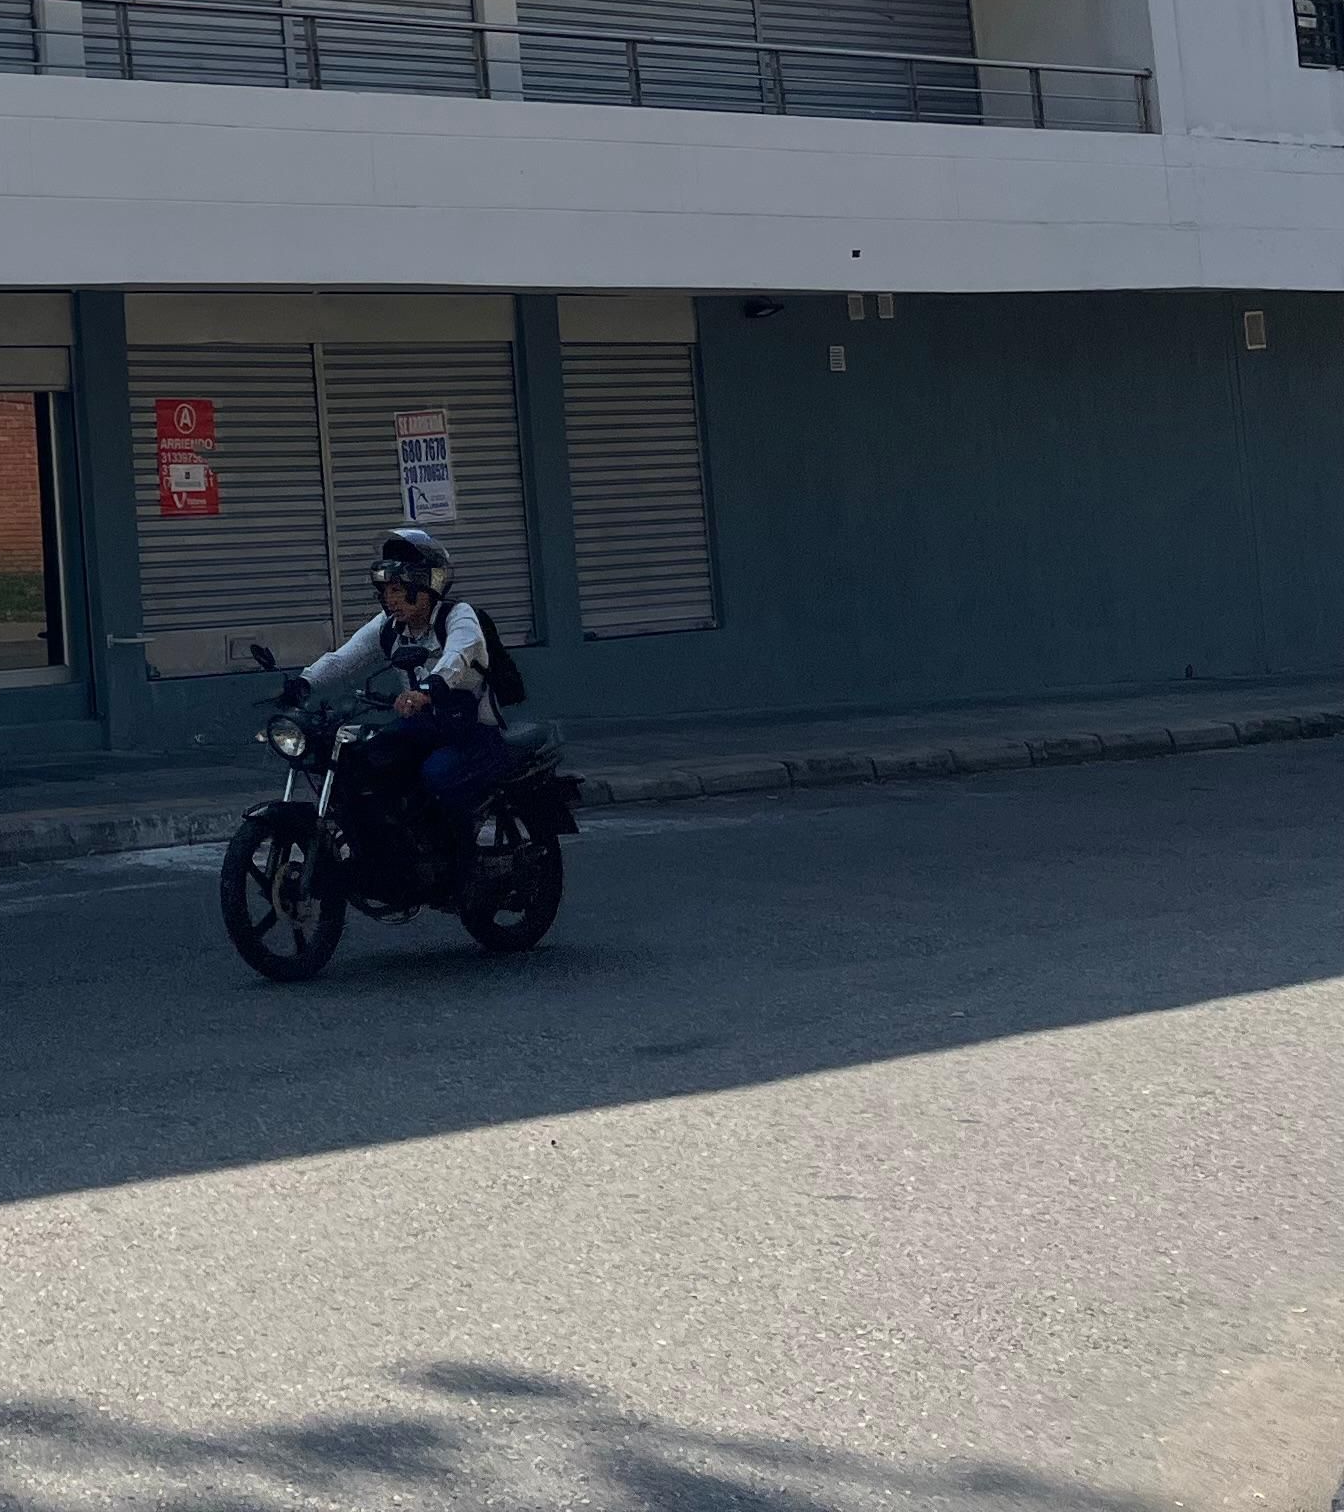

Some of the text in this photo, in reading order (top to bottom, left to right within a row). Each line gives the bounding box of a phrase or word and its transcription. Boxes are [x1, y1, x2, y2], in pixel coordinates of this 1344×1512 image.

[179, 407, 192, 427] A
[160, 438, 214, 450] ARRIENDO
[401, 436, 447, 464] 680 7678
